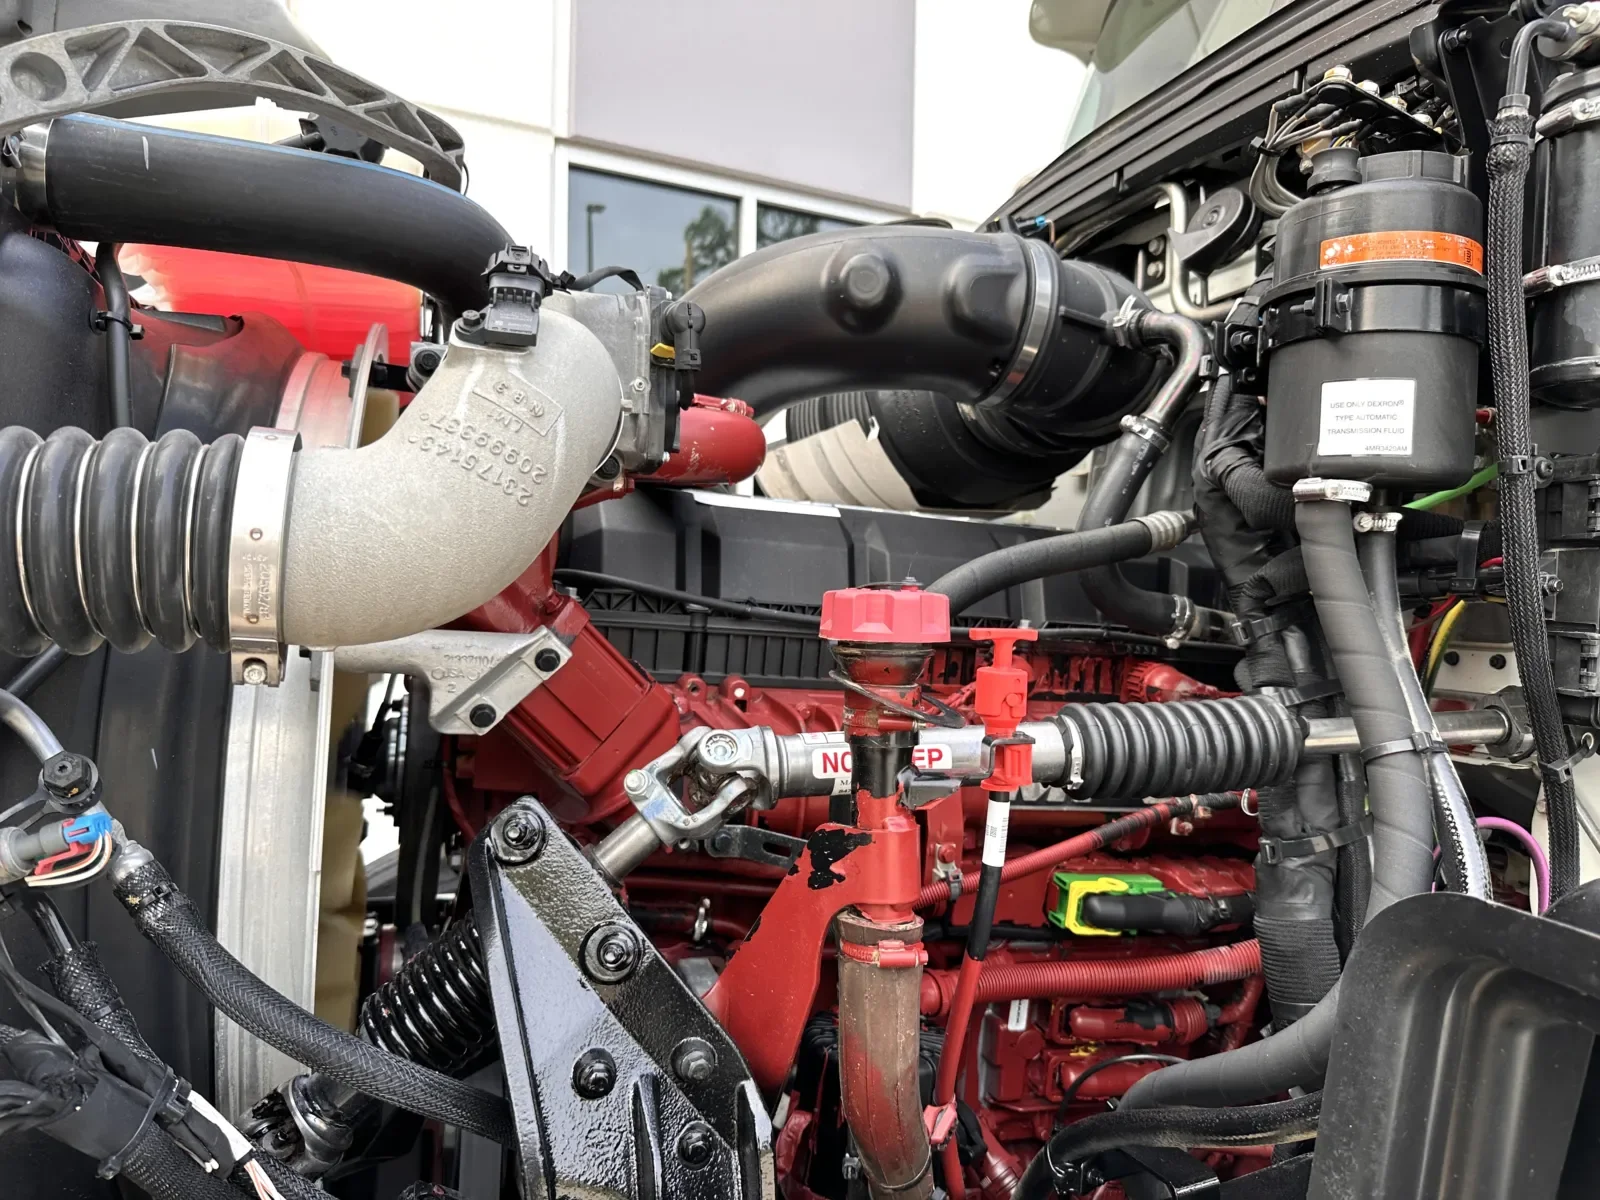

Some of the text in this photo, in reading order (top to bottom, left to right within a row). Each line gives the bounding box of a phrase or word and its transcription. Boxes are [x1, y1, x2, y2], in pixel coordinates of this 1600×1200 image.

[1330, 401, 1345, 409] USE
[1346, 400, 1365, 408] ONLY
[1335, 413, 1398, 422] TYPE AUTOMATIC
[1327, 427, 1405, 436] TRANSMISSION FLUID
